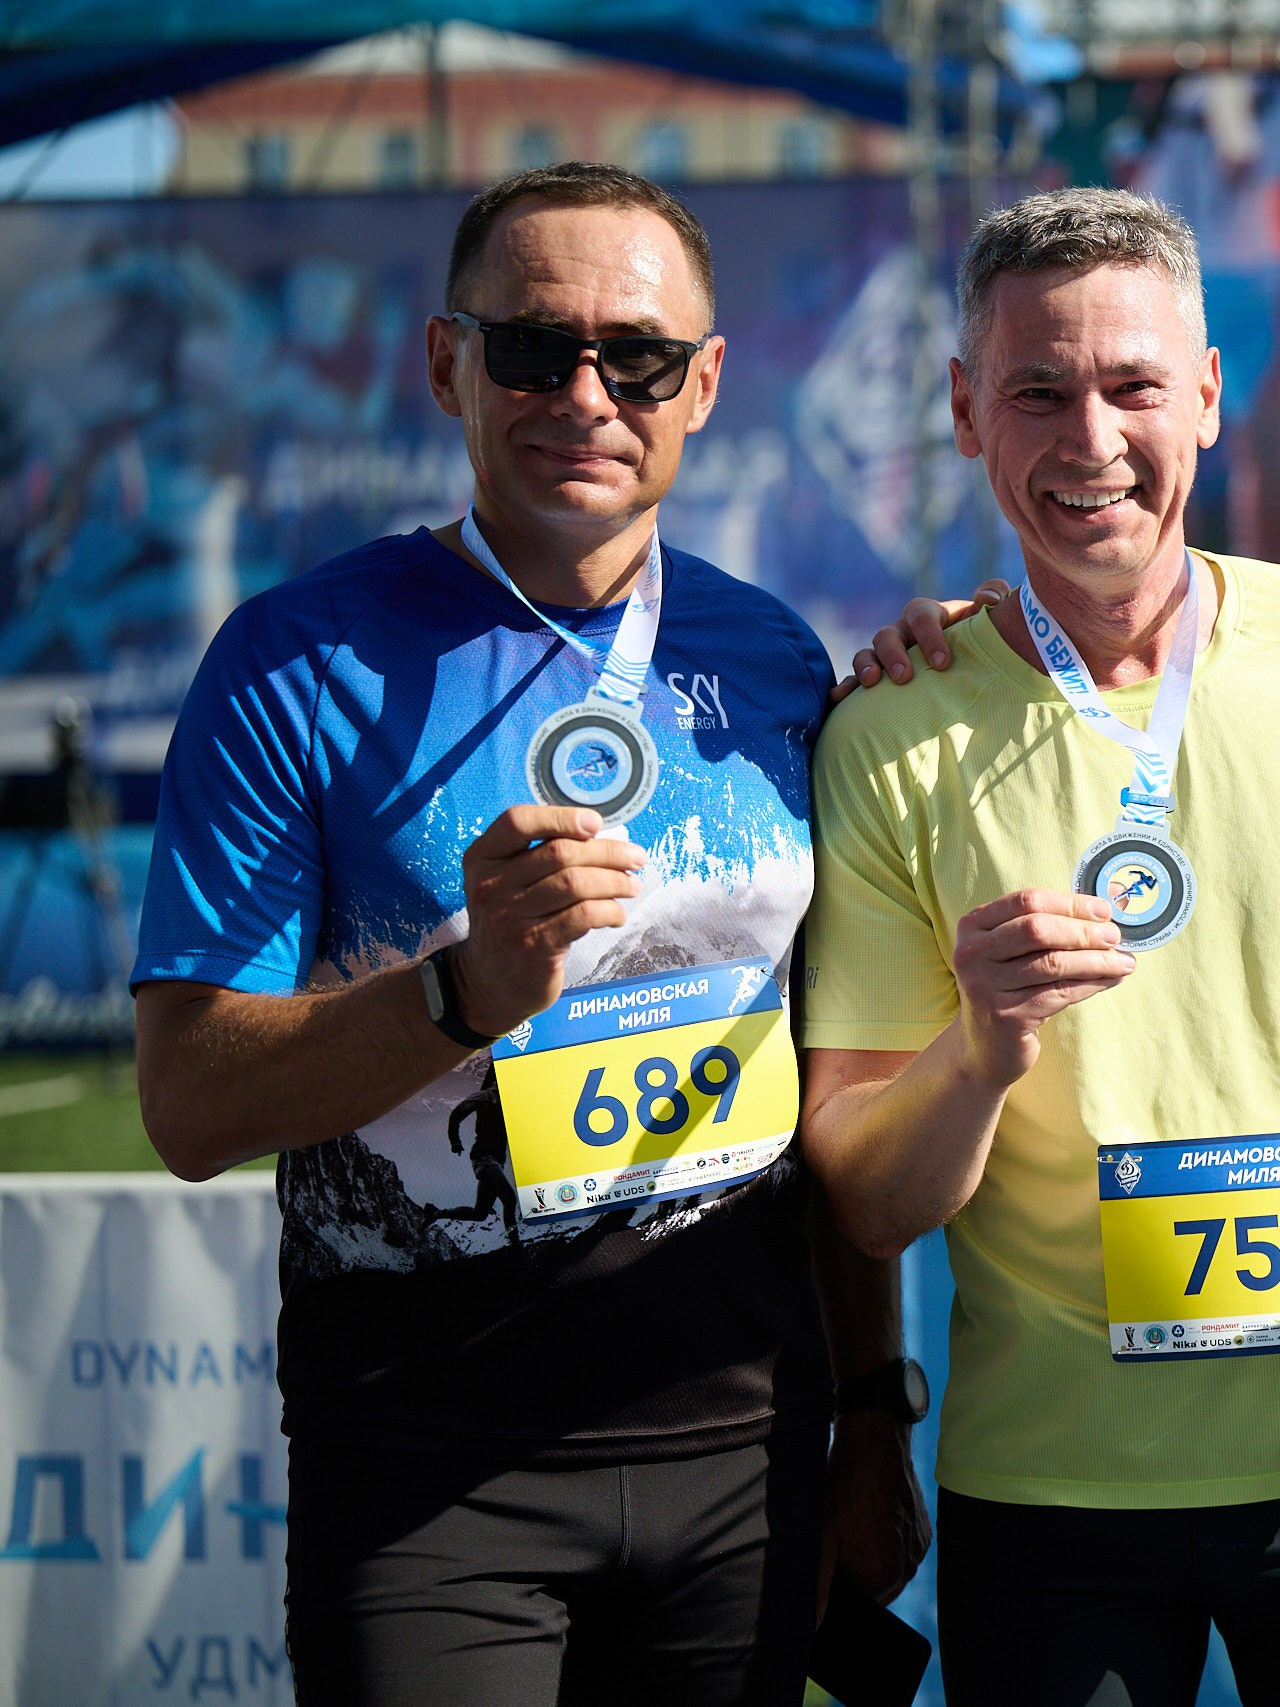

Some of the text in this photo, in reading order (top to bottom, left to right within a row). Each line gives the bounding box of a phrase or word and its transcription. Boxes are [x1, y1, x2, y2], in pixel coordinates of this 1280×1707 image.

[1045, 634, 1089, 695] БЕЖИТ!
[677, 716, 717, 730] ENERGY
[1090, 840, 1108, 854] СИЛА
[1113, 832, 1151, 842] ДВИЖЕНИИ
[567, 978, 709, 1021] ДИНАМОВСКАЯ
[618, 1006, 671, 1030] МИЛЯ
[573, 1045, 741, 1147] 689
[613, 1169, 651, 1182] РОНДАМИТ
[586, 1185, 645, 1204] Nika UDS
[1201, 1323, 1240, 1332] РОНДАМИТ
[1173, 1338, 1232, 1349] Nika UDS
[71, 1339, 279, 1388] DYNAM
